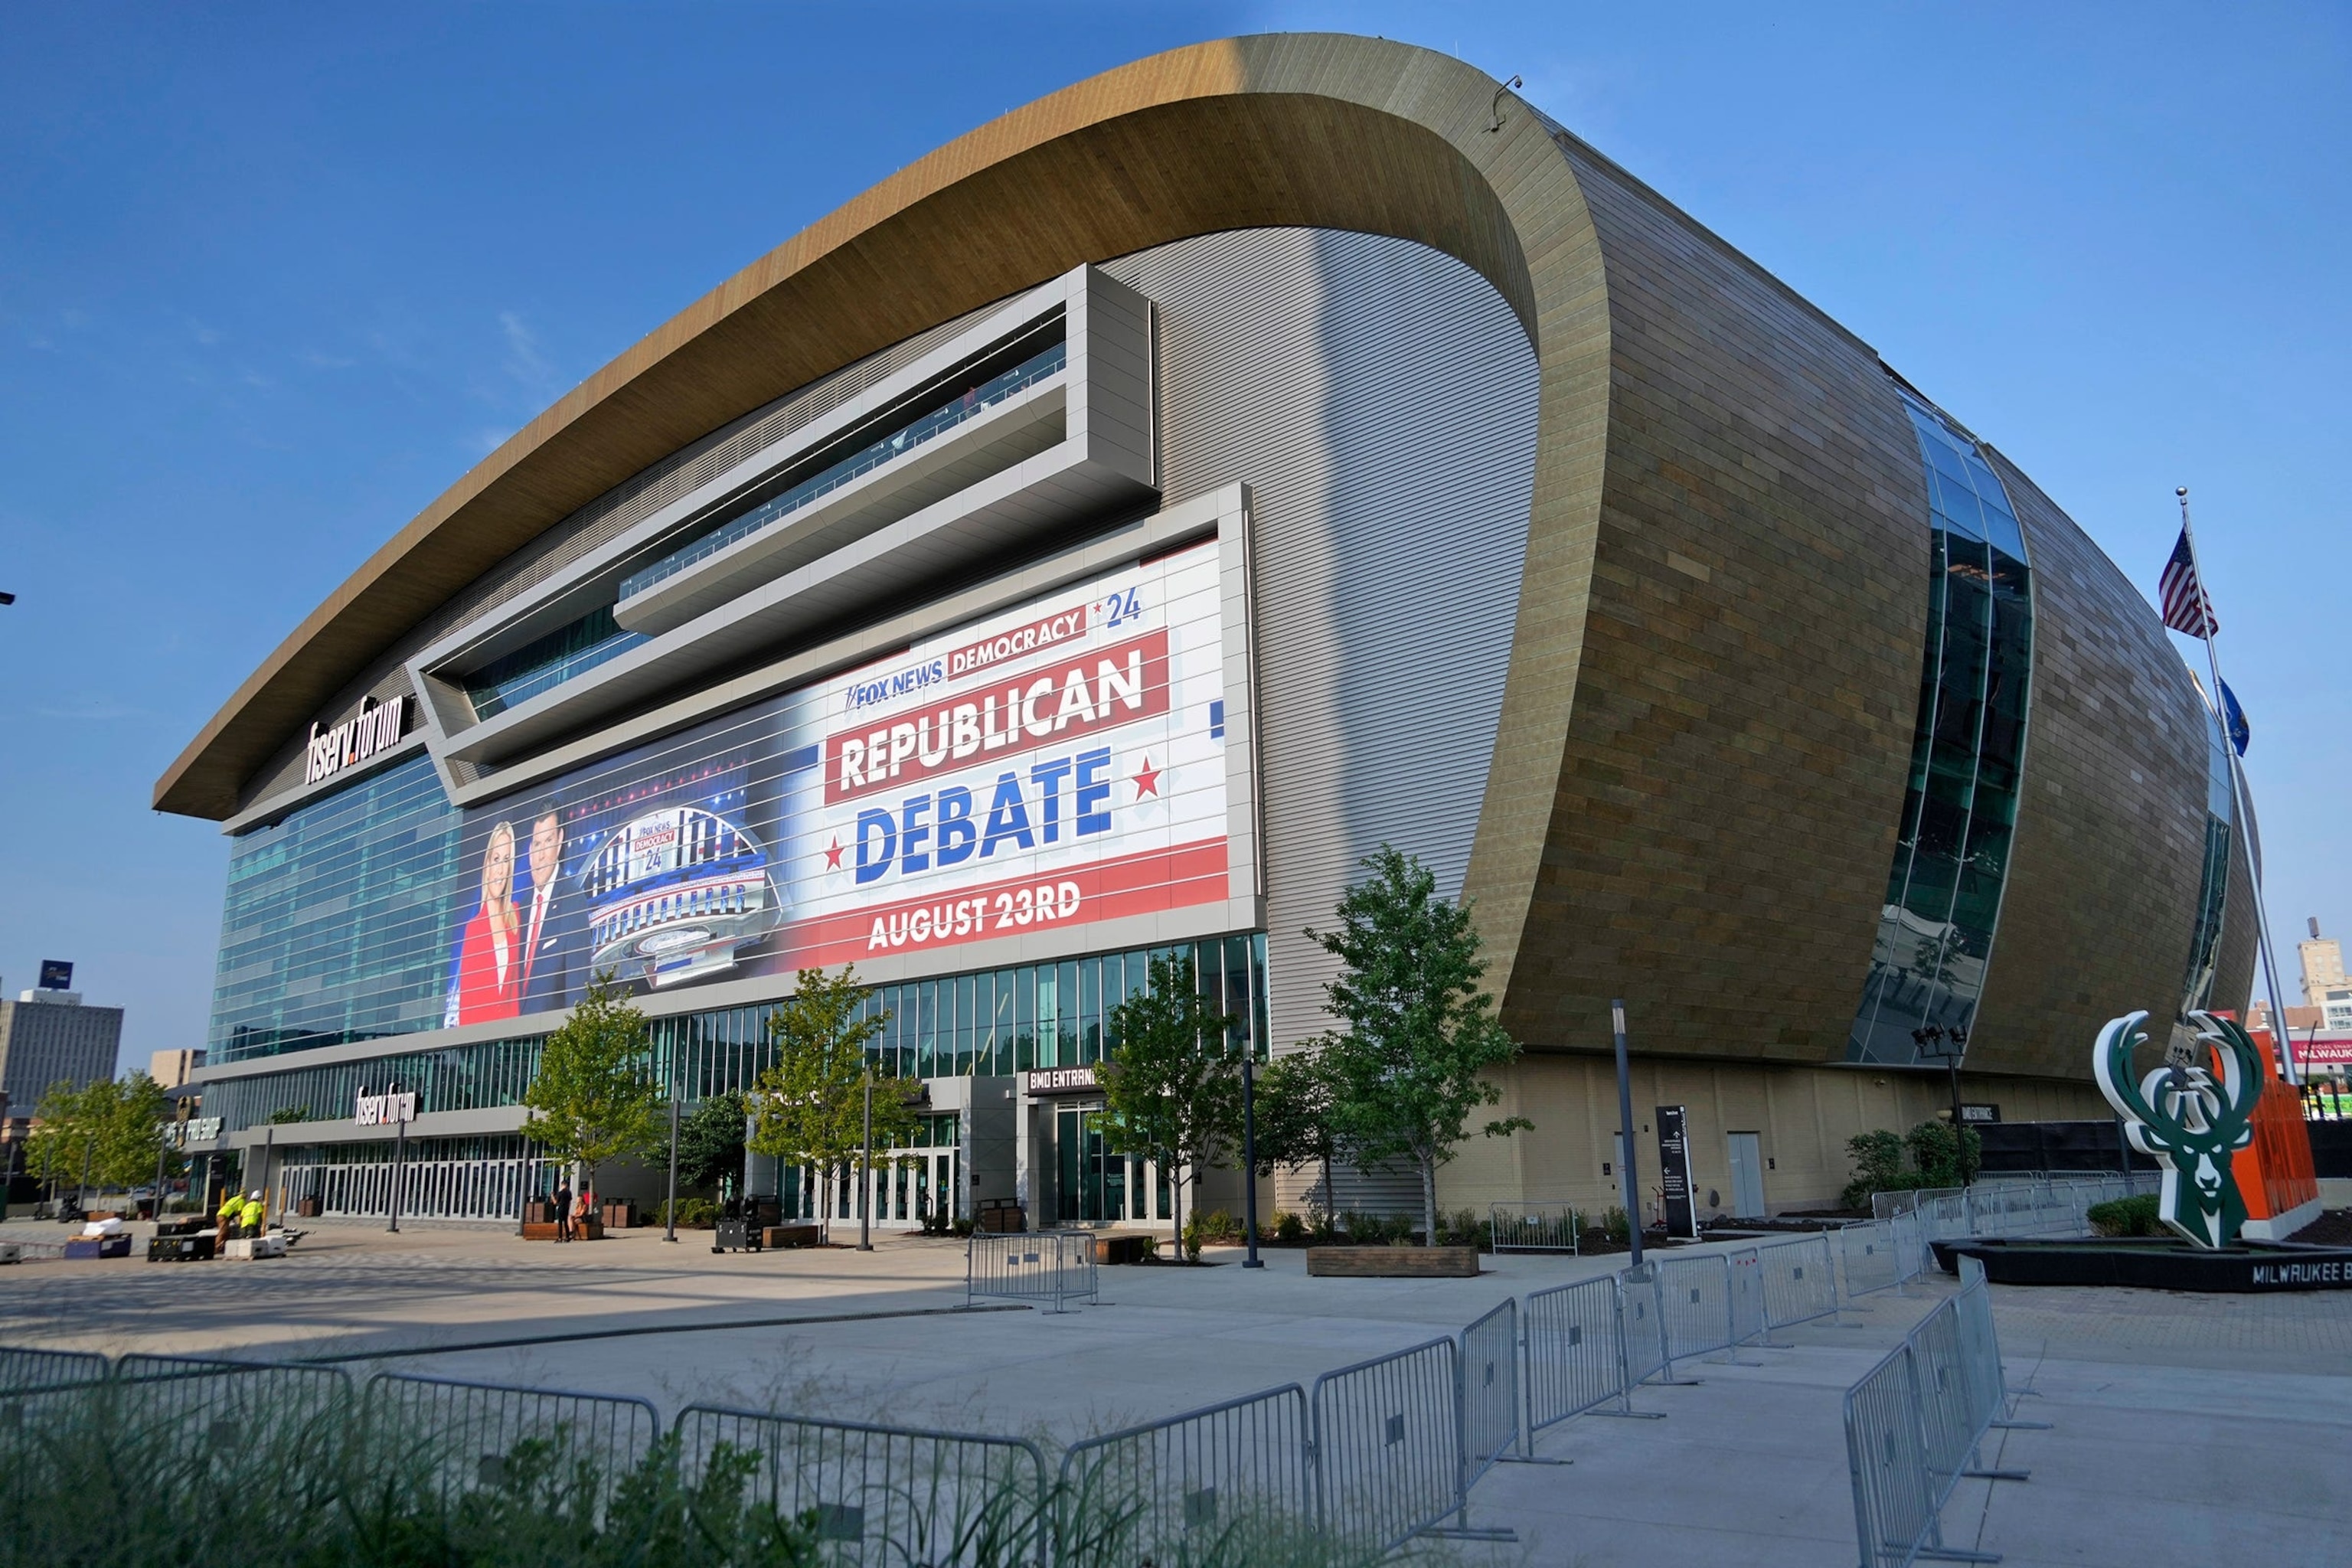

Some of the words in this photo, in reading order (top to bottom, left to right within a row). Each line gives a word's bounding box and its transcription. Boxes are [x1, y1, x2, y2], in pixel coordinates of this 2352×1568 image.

[856, 678, 889, 710] FOX
[892, 659, 943, 698] NEWS
[952, 610, 1080, 675] DEMOCRACY
[1106, 586, 1142, 629] 24
[840, 648, 1142, 792] REPUBLICAN
[854, 746, 1112, 886] DEBATE
[635, 830, 675, 851] DEMOCRACY
[645, 846, 662, 871] 24
[867, 897, 988, 952] AUGUST
[994, 880, 1081, 930] 23RD
[1030, 1071, 1051, 1089] BMO
[1052, 1067, 1100, 1088] ENTRAN
[2252, 1262, 2341, 1285] MILWAUKEE
